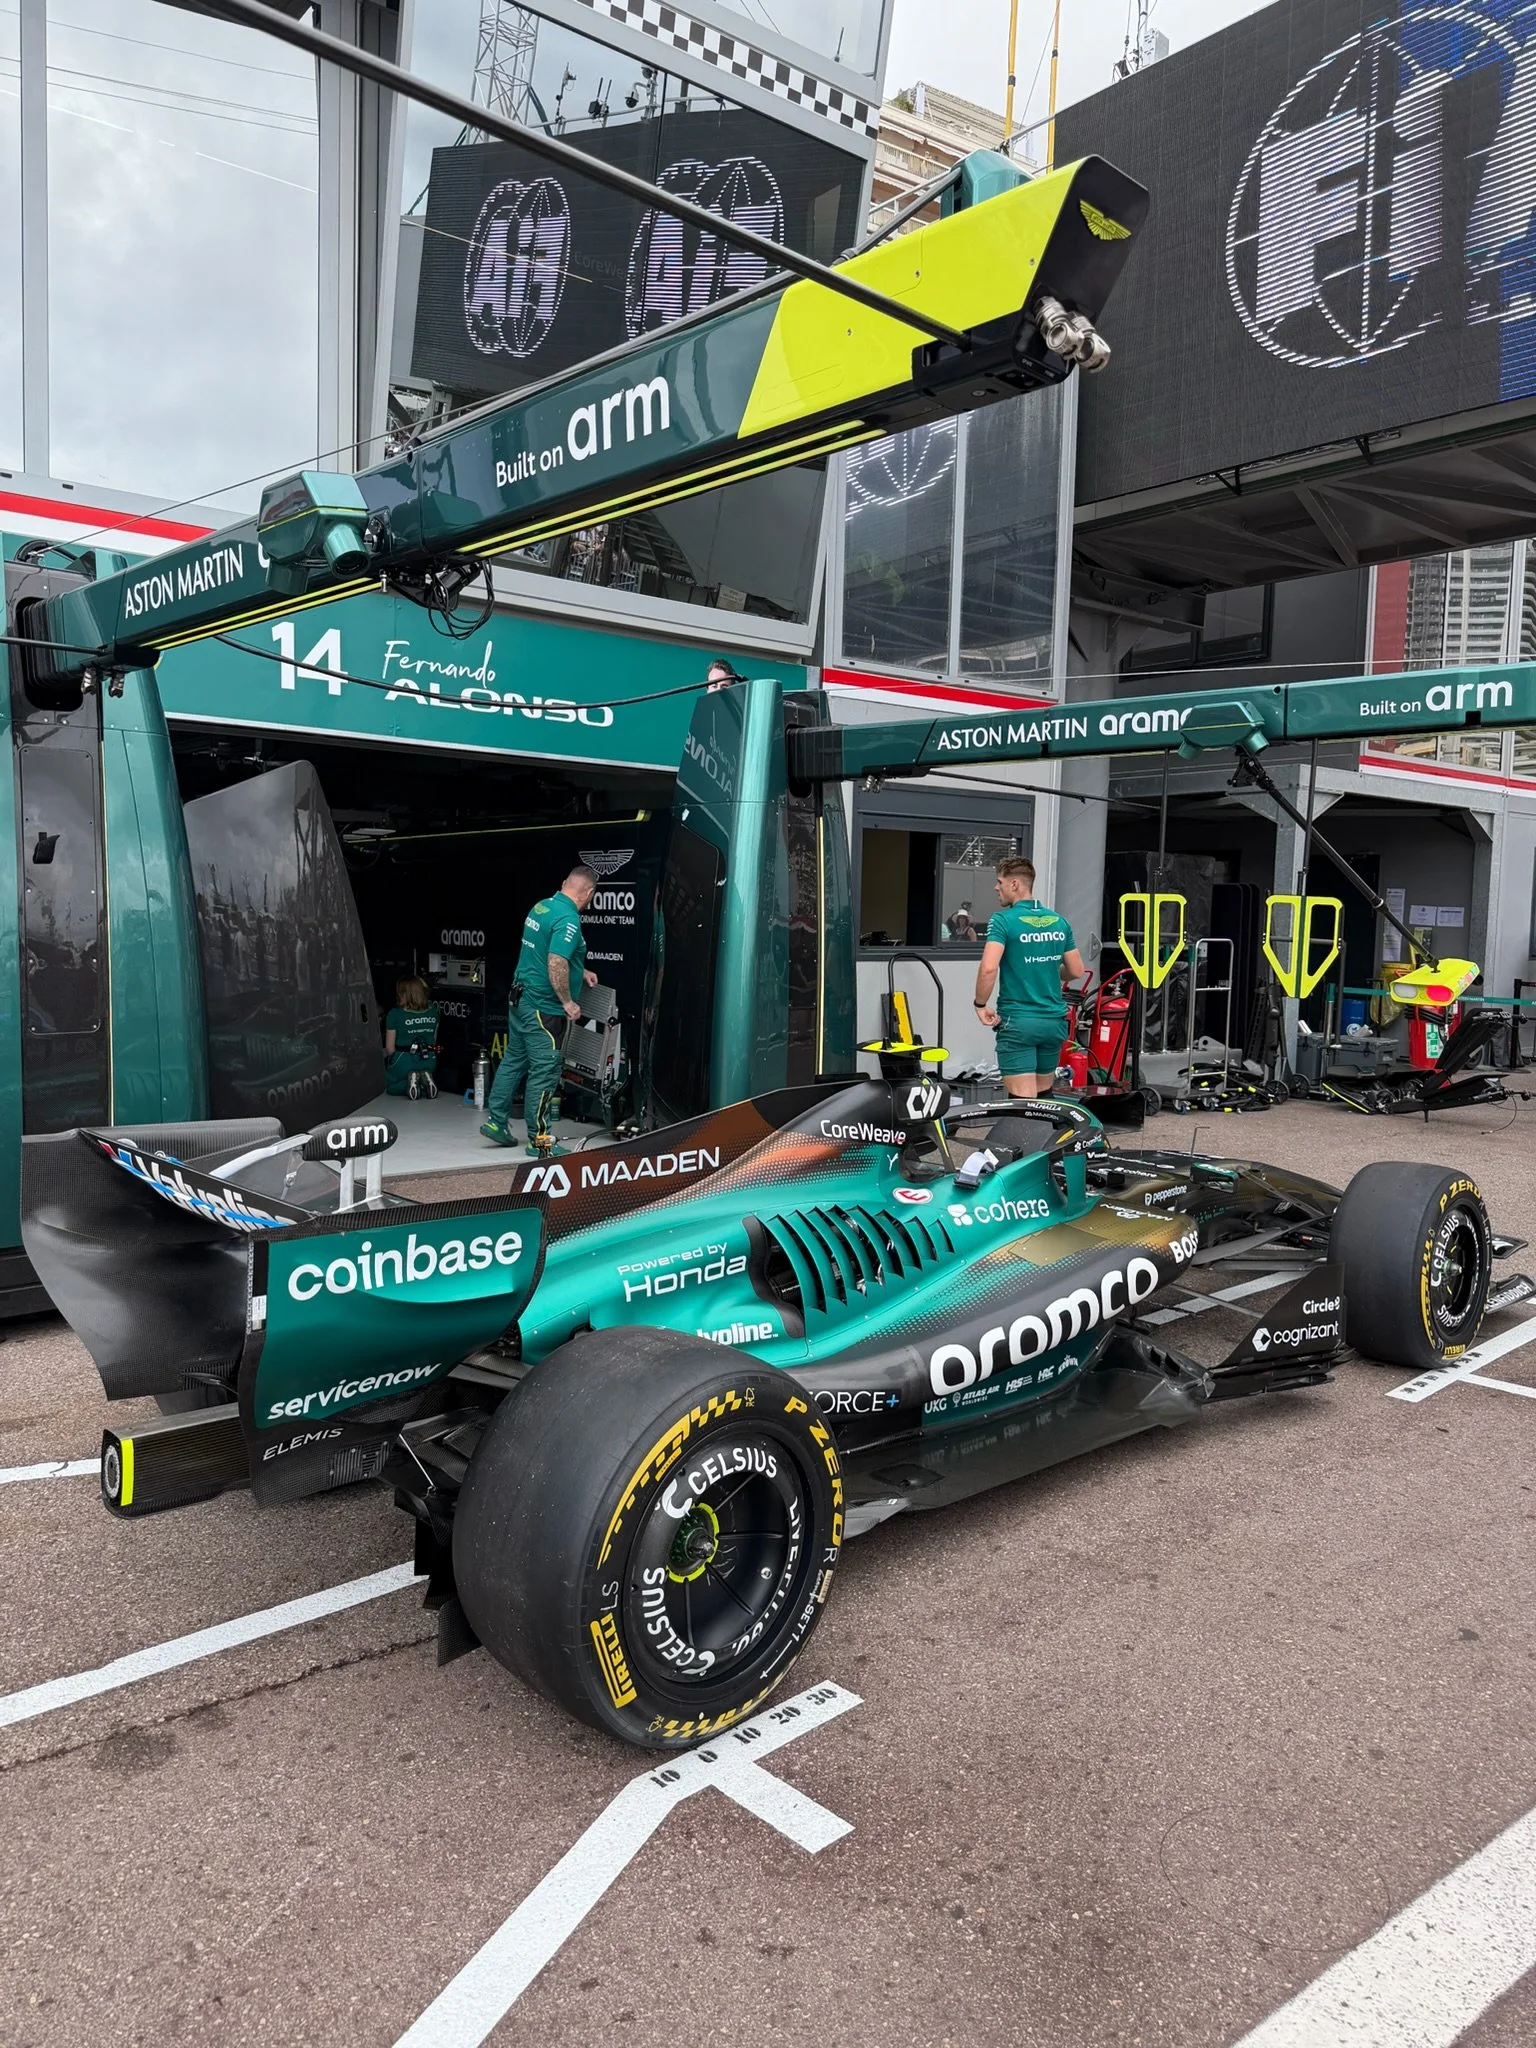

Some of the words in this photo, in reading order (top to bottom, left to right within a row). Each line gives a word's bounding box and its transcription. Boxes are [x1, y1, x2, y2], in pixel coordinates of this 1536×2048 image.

[496, 449, 537, 488] Built
[540, 443, 563, 472] on
[567, 376, 670, 462] arm
[124, 567, 176, 619] ASTON
[176, 544, 244, 600] MARTIN
[271, 621, 348, 697] 14
[381, 640, 497, 687] Fernando
[384, 677, 614, 727] ALONSO
[1360, 700, 1396, 716] Built
[1400, 699, 1421, 713] on
[1425, 680, 1513, 711] arm
[937, 723, 1002, 751] ASTON
[1007, 716, 1088, 745] MARTIN
[1099, 707, 1193, 736] aram
[587, 892, 635, 911] amco
[579, 914, 603, 924] ORMULA
[441, 929, 485, 947] aramco
[1019, 931, 1066, 943] aramco
[594, 951, 624, 961] MAADEN
[405, 1016, 436, 1026] aramco
[1027, 1102, 1062, 1112] VALHALLA
[326, 1123, 389, 1150] arm
[820, 1119, 906, 1145] CoreWeave
[581, 1146, 720, 1189] MAADEN
[974, 1197, 1050, 1224] cohere
[1152, 1184, 1188, 1204] pepperstone
[1439, 1193, 1451, 1213] P
[1449, 1179, 1482, 1200] ZERO
[1434, 1214, 1460, 1268] CELSIUS
[287, 1231, 522, 1301] coinbase
[617, 1246, 703, 1276] Powered
[707, 1242, 728, 1263] by
[623, 1254, 747, 1302] Honda
[696, 1321, 774, 1346] voline
[929, 1257, 1159, 1396] aramco
[1273, 1320, 1339, 1347] cognizant
[266, 1362, 442, 1421] servicenow
[809, 1390, 900, 1414] ORCE+
[924, 1397, 948, 1414] UKG
[962, 1387, 987, 1401] ATLAS
[987, 1384, 1000, 1394] AIR
[262, 1427, 344, 1461] ELEMIS
[687, 1446, 778, 1496] CELSIUS
[784, 1396, 808, 1415] P
[809, 1418, 845, 1548] ZERO
[643, 1566, 699, 1671] CELSIUS
[797, 1603, 815, 1635] SET
[791, 1632, 800, 1643] 1
[590, 1612, 638, 1709] PIRELLI
[650, 1769, 681, 1788] 10
[698, 1751, 718, 1763] 0
[732, 1727, 762, 1744] 10
[770, 1706, 802, 1724] 20
[806, 1688, 838, 1706] 30
